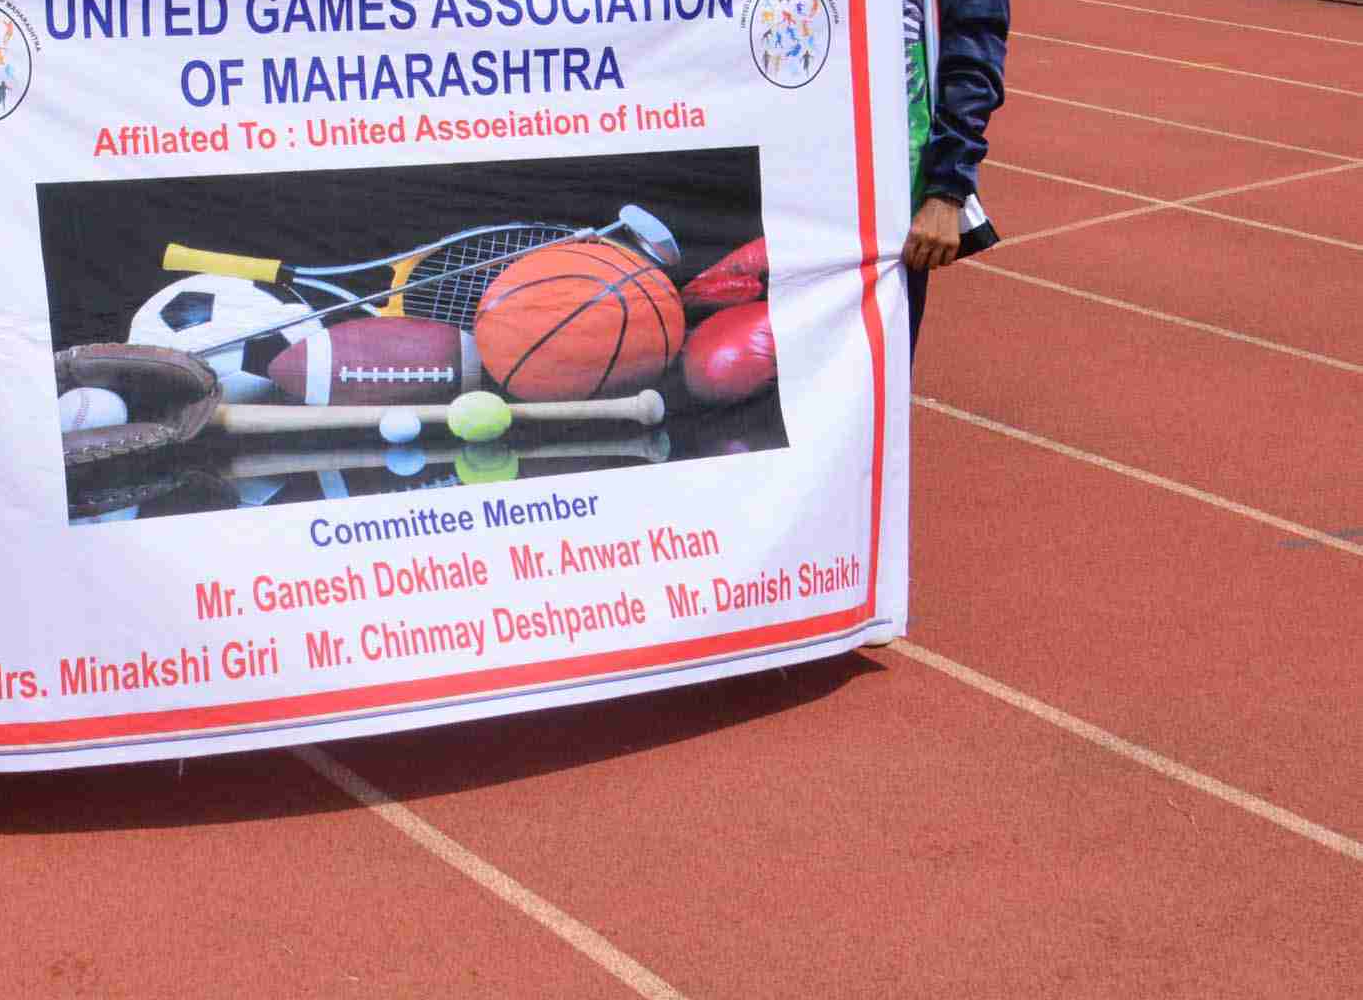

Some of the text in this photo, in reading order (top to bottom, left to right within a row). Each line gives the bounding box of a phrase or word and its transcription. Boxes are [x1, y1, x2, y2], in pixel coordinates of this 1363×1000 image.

[181, 47, 624, 107] OF MAHARASHTRA
[93, 125, 230, 156] Affilated
[307, 116, 405, 147] United
[600, 104, 626, 132] of
[636, 103, 705, 130] India
[310, 494, 598, 547] Committee Member
[196, 527, 719, 620] Mr. Ganesh Dokhale Mr. Anwar Khan
[60, 645, 210, 695] Minakshi
[221, 637, 279, 680] Giri
[306, 631, 351, 668] Mr.
[361, 619, 485, 661] Chinmay
[493, 592, 646, 643] Deshpande
[666, 583, 707, 618] Mr.
[712, 567, 791, 613] Danish
[798, 553, 860, 598] Shaikh
